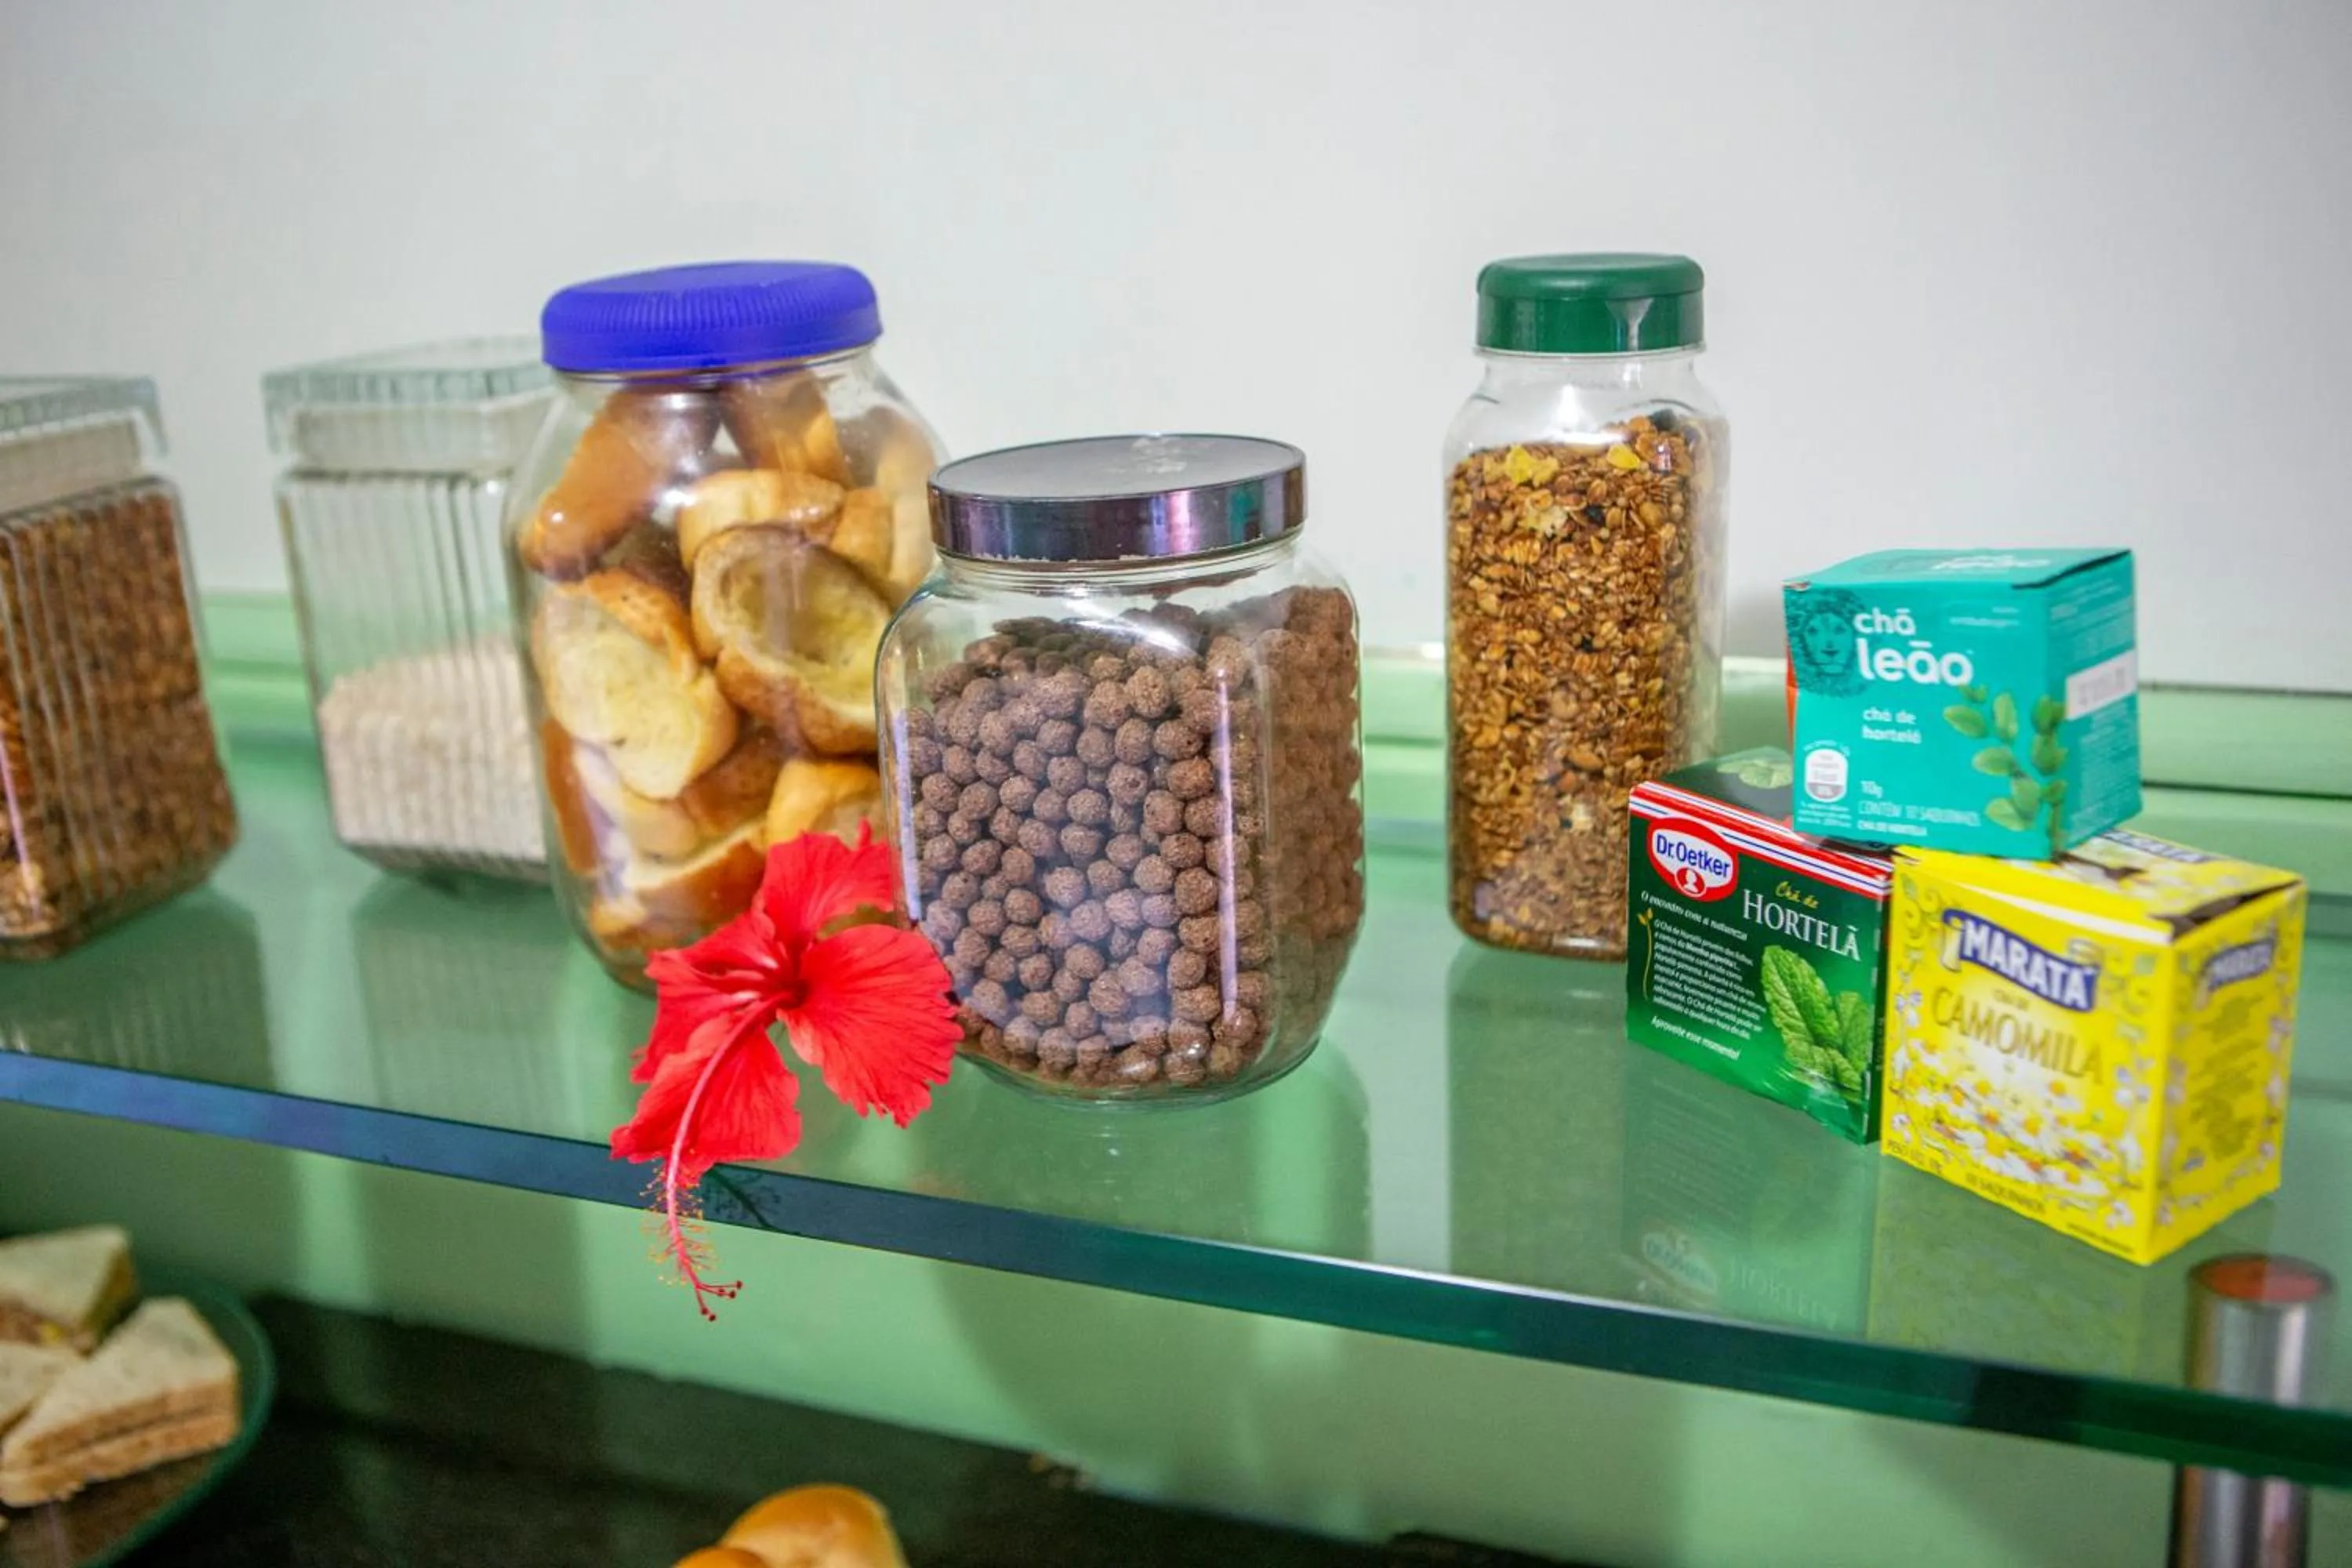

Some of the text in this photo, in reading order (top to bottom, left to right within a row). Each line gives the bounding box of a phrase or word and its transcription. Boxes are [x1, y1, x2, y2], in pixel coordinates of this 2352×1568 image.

[1676, 841, 1731, 879] Oetker
[1743, 888, 1861, 961] HORTELÃ
[1933, 986, 2103, 1086] CAMOMILA
